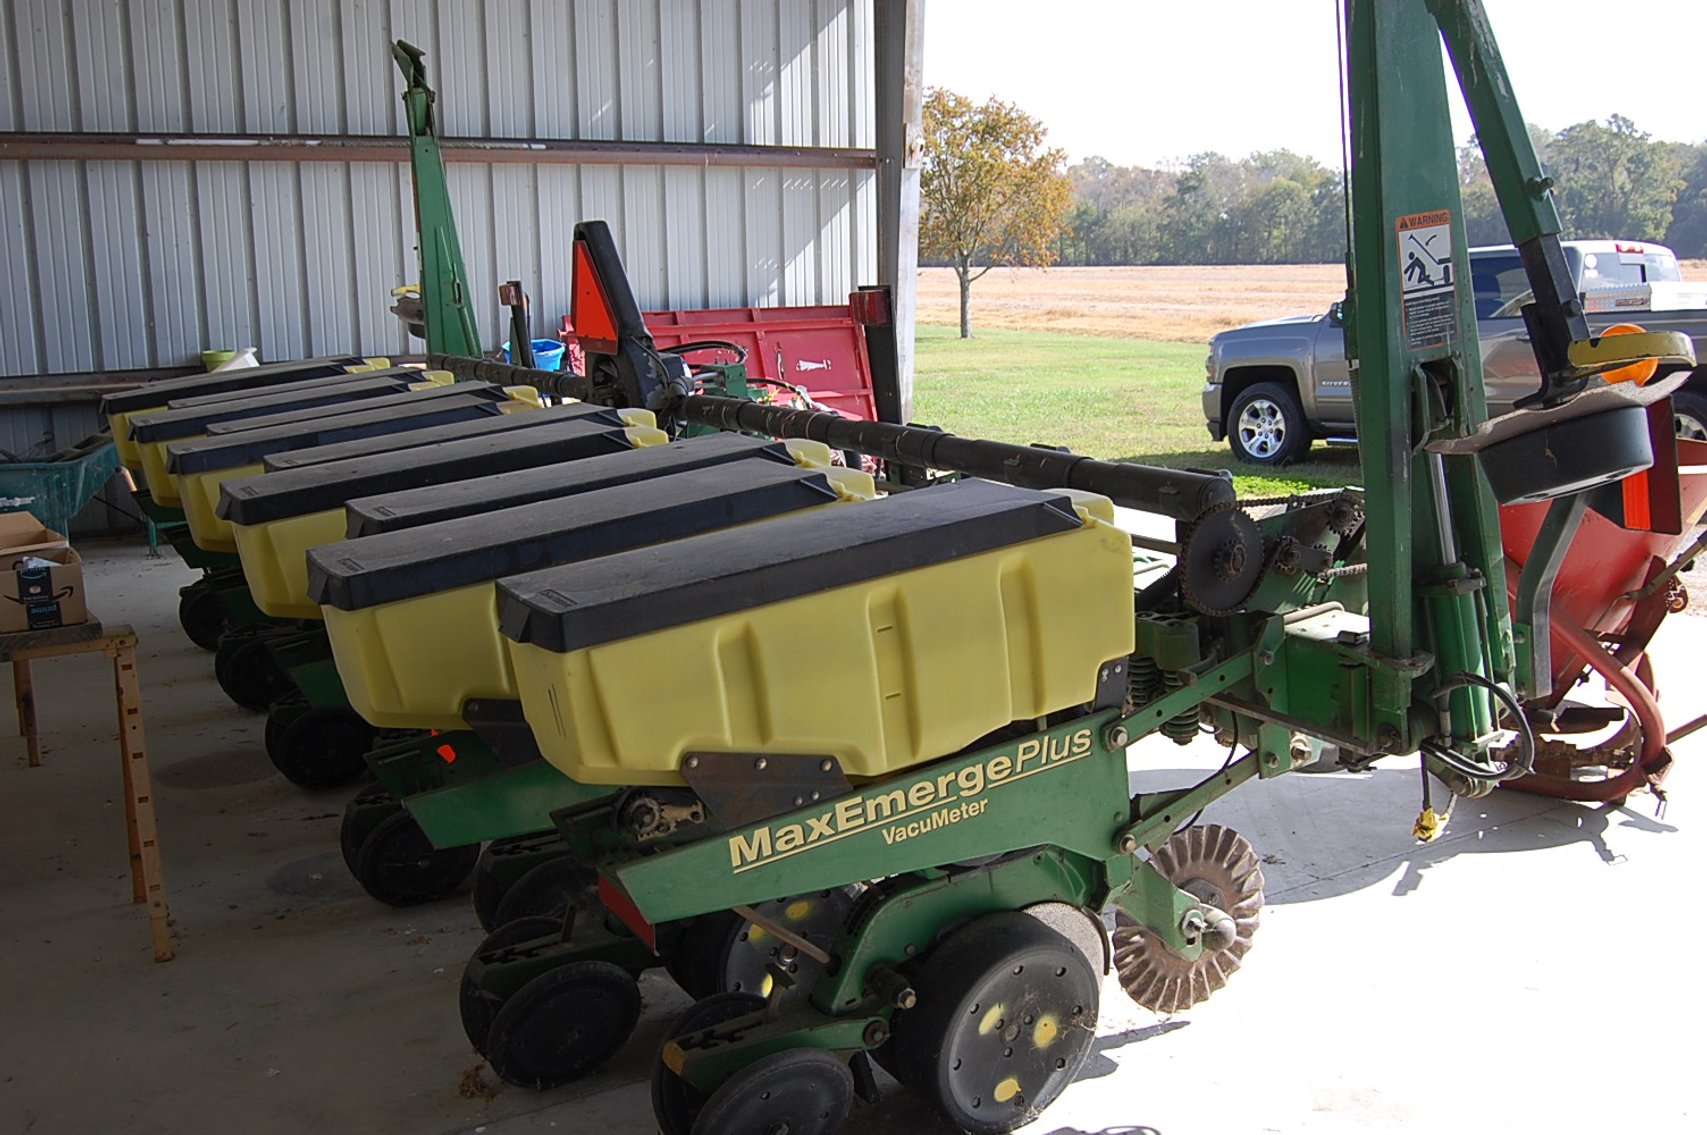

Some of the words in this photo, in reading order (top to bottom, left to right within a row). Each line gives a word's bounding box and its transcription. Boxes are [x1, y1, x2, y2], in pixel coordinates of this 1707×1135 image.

[1409, 212, 1448, 227] WARNING
[728, 728, 1092, 867] MaxEmergePlus
[881, 798, 989, 845] VacuMeter
